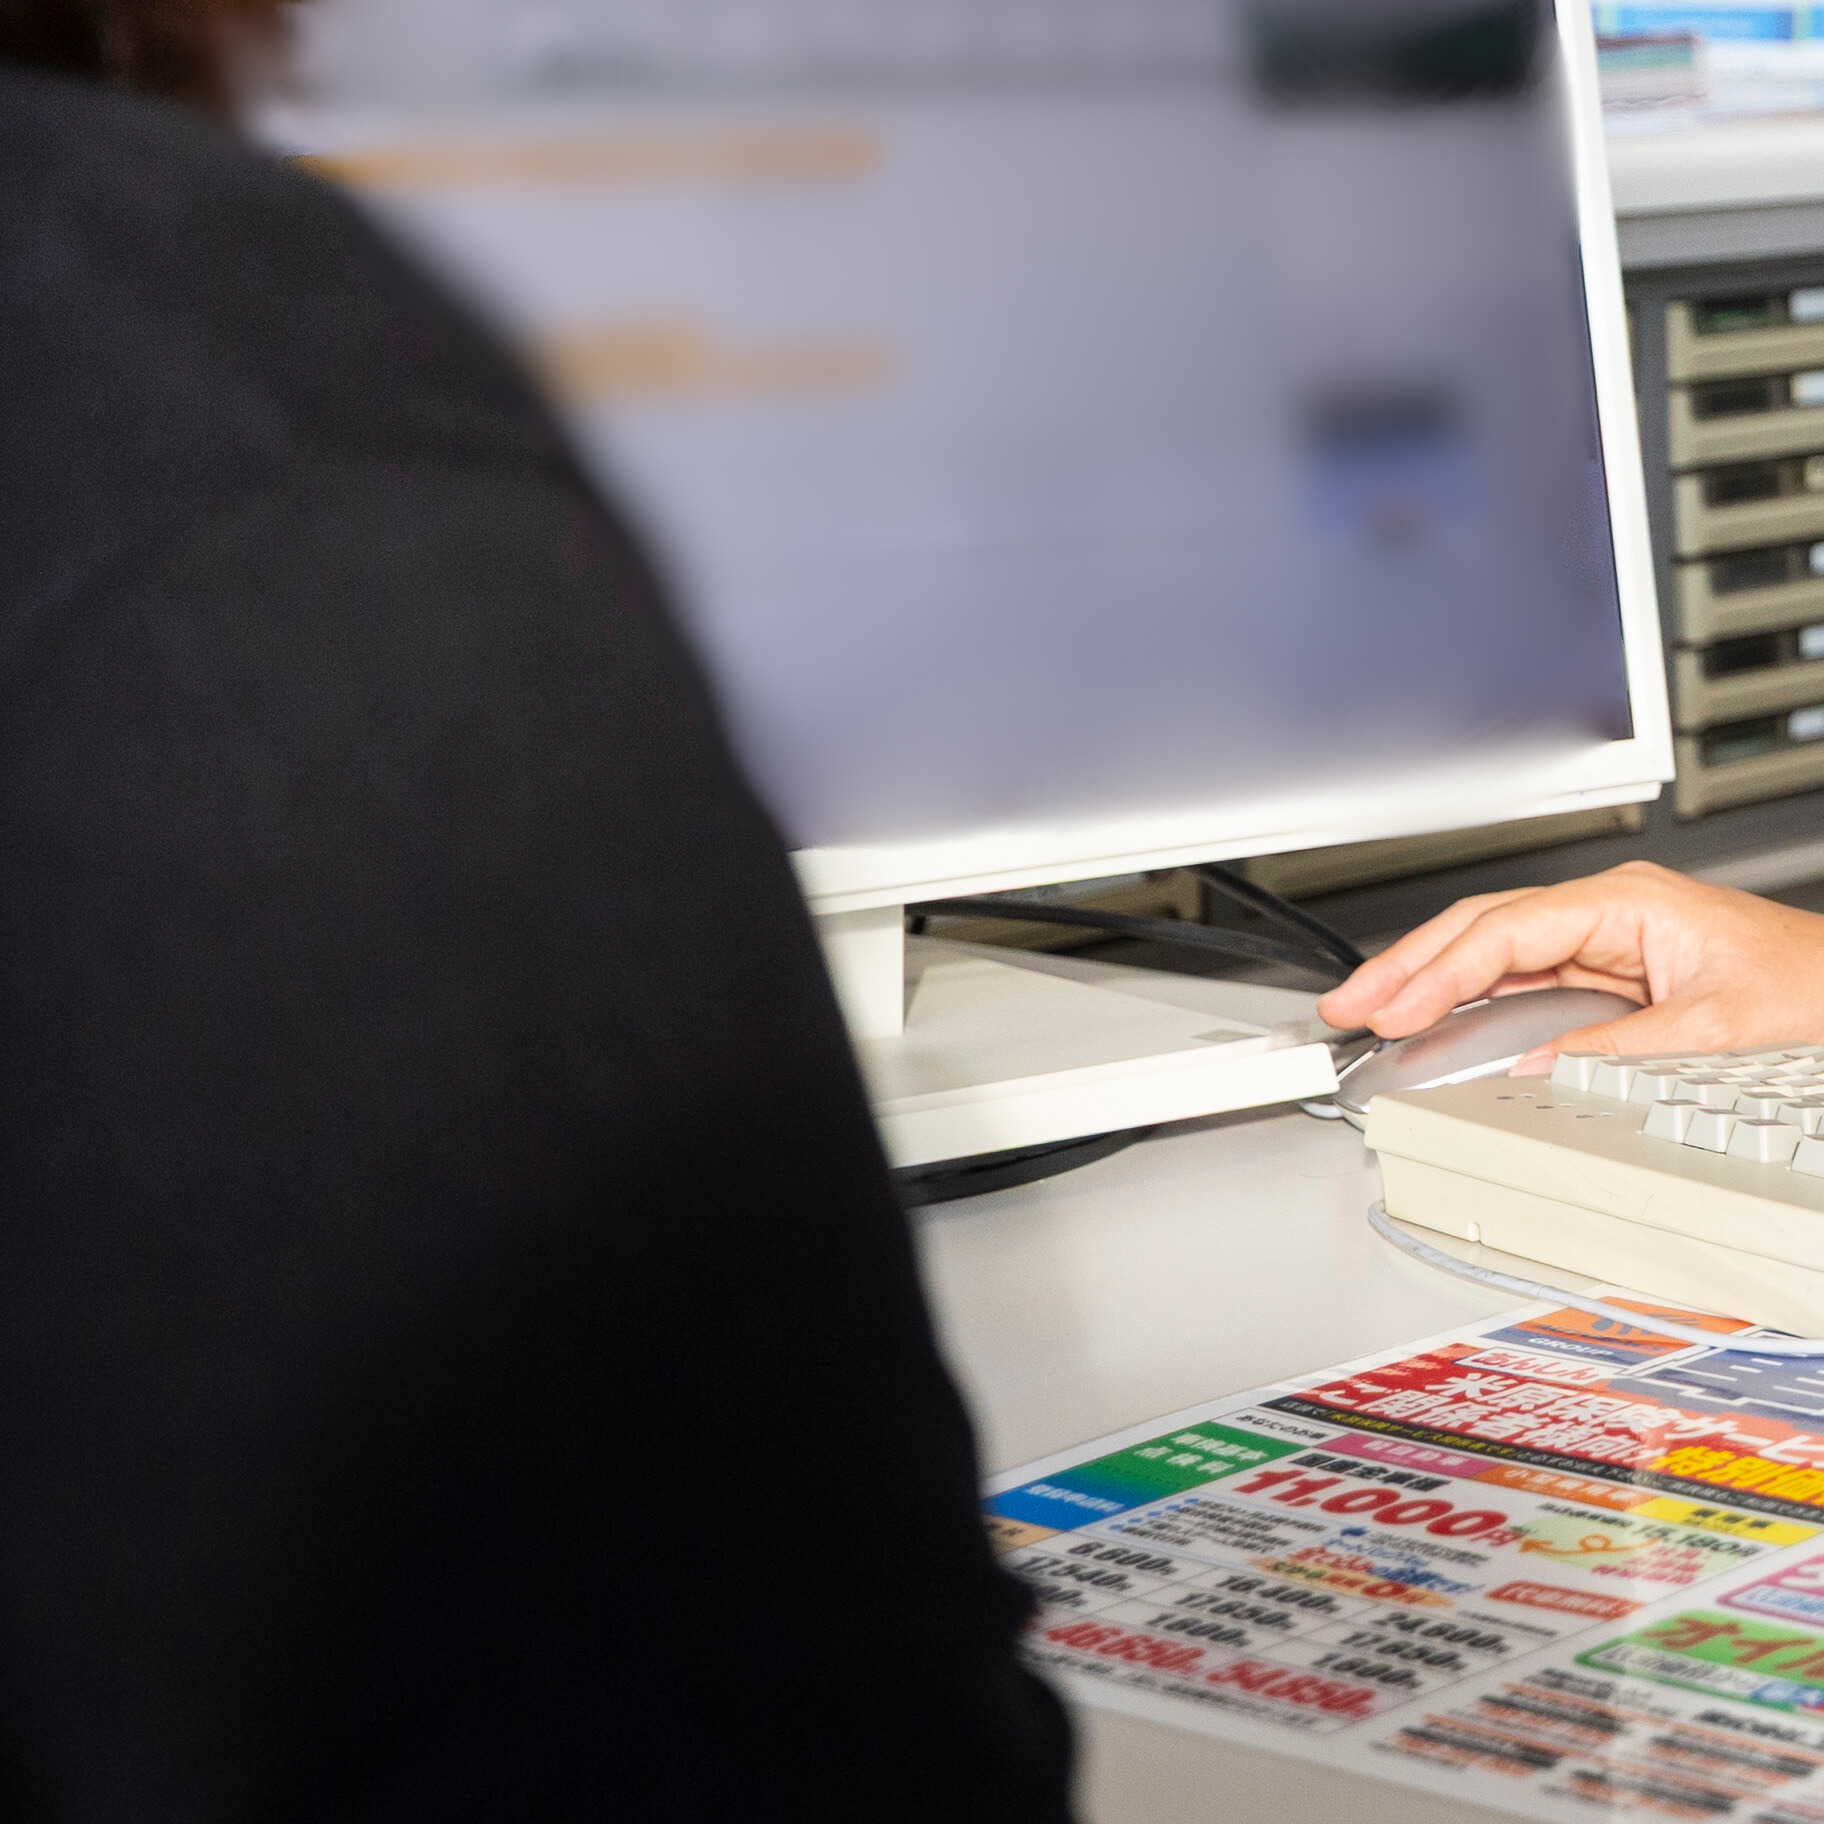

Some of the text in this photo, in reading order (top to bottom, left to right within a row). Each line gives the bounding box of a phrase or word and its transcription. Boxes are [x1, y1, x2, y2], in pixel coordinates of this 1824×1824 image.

[1527, 1336, 1614, 1357] GROUP
[1470, 1351, 1602, 1381] あんしん
[1231, 1468, 1527, 1548] 11,000円
